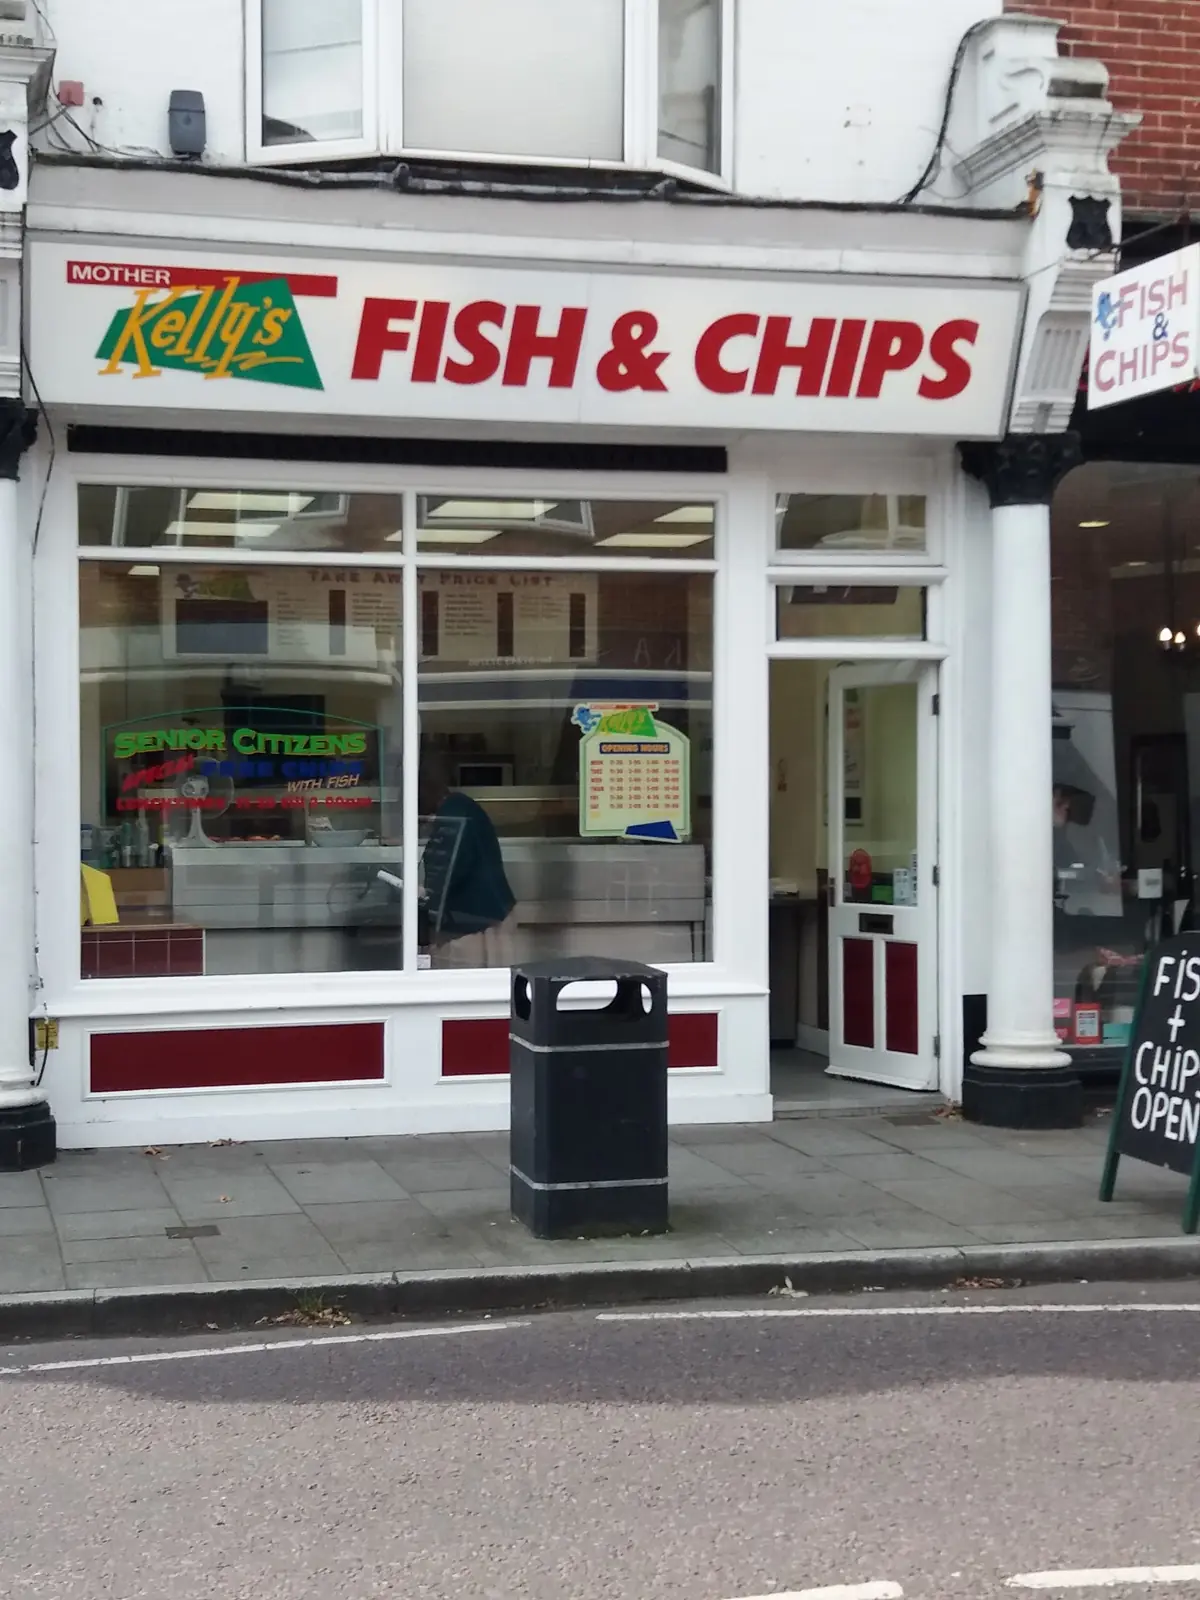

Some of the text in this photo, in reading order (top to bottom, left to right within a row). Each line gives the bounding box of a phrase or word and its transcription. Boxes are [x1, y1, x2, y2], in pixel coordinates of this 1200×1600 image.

[71, 264, 171, 285] MOTHER
[1119, 271, 1187, 327] FISH
[97, 276, 302, 380] Kelly's
[1152, 312, 1169, 341] &
[350, 297, 979, 400] FISH & CHIPS
[1096, 332, 1189, 392] CHIPS
[307, 569, 553, 587] TAKE AWY PRICE LIST
[114, 728, 367, 758] SENIOR CITIZENS
[287, 774, 360, 793] WITH FISH
[1131, 1086, 1200, 1144] OPEN
